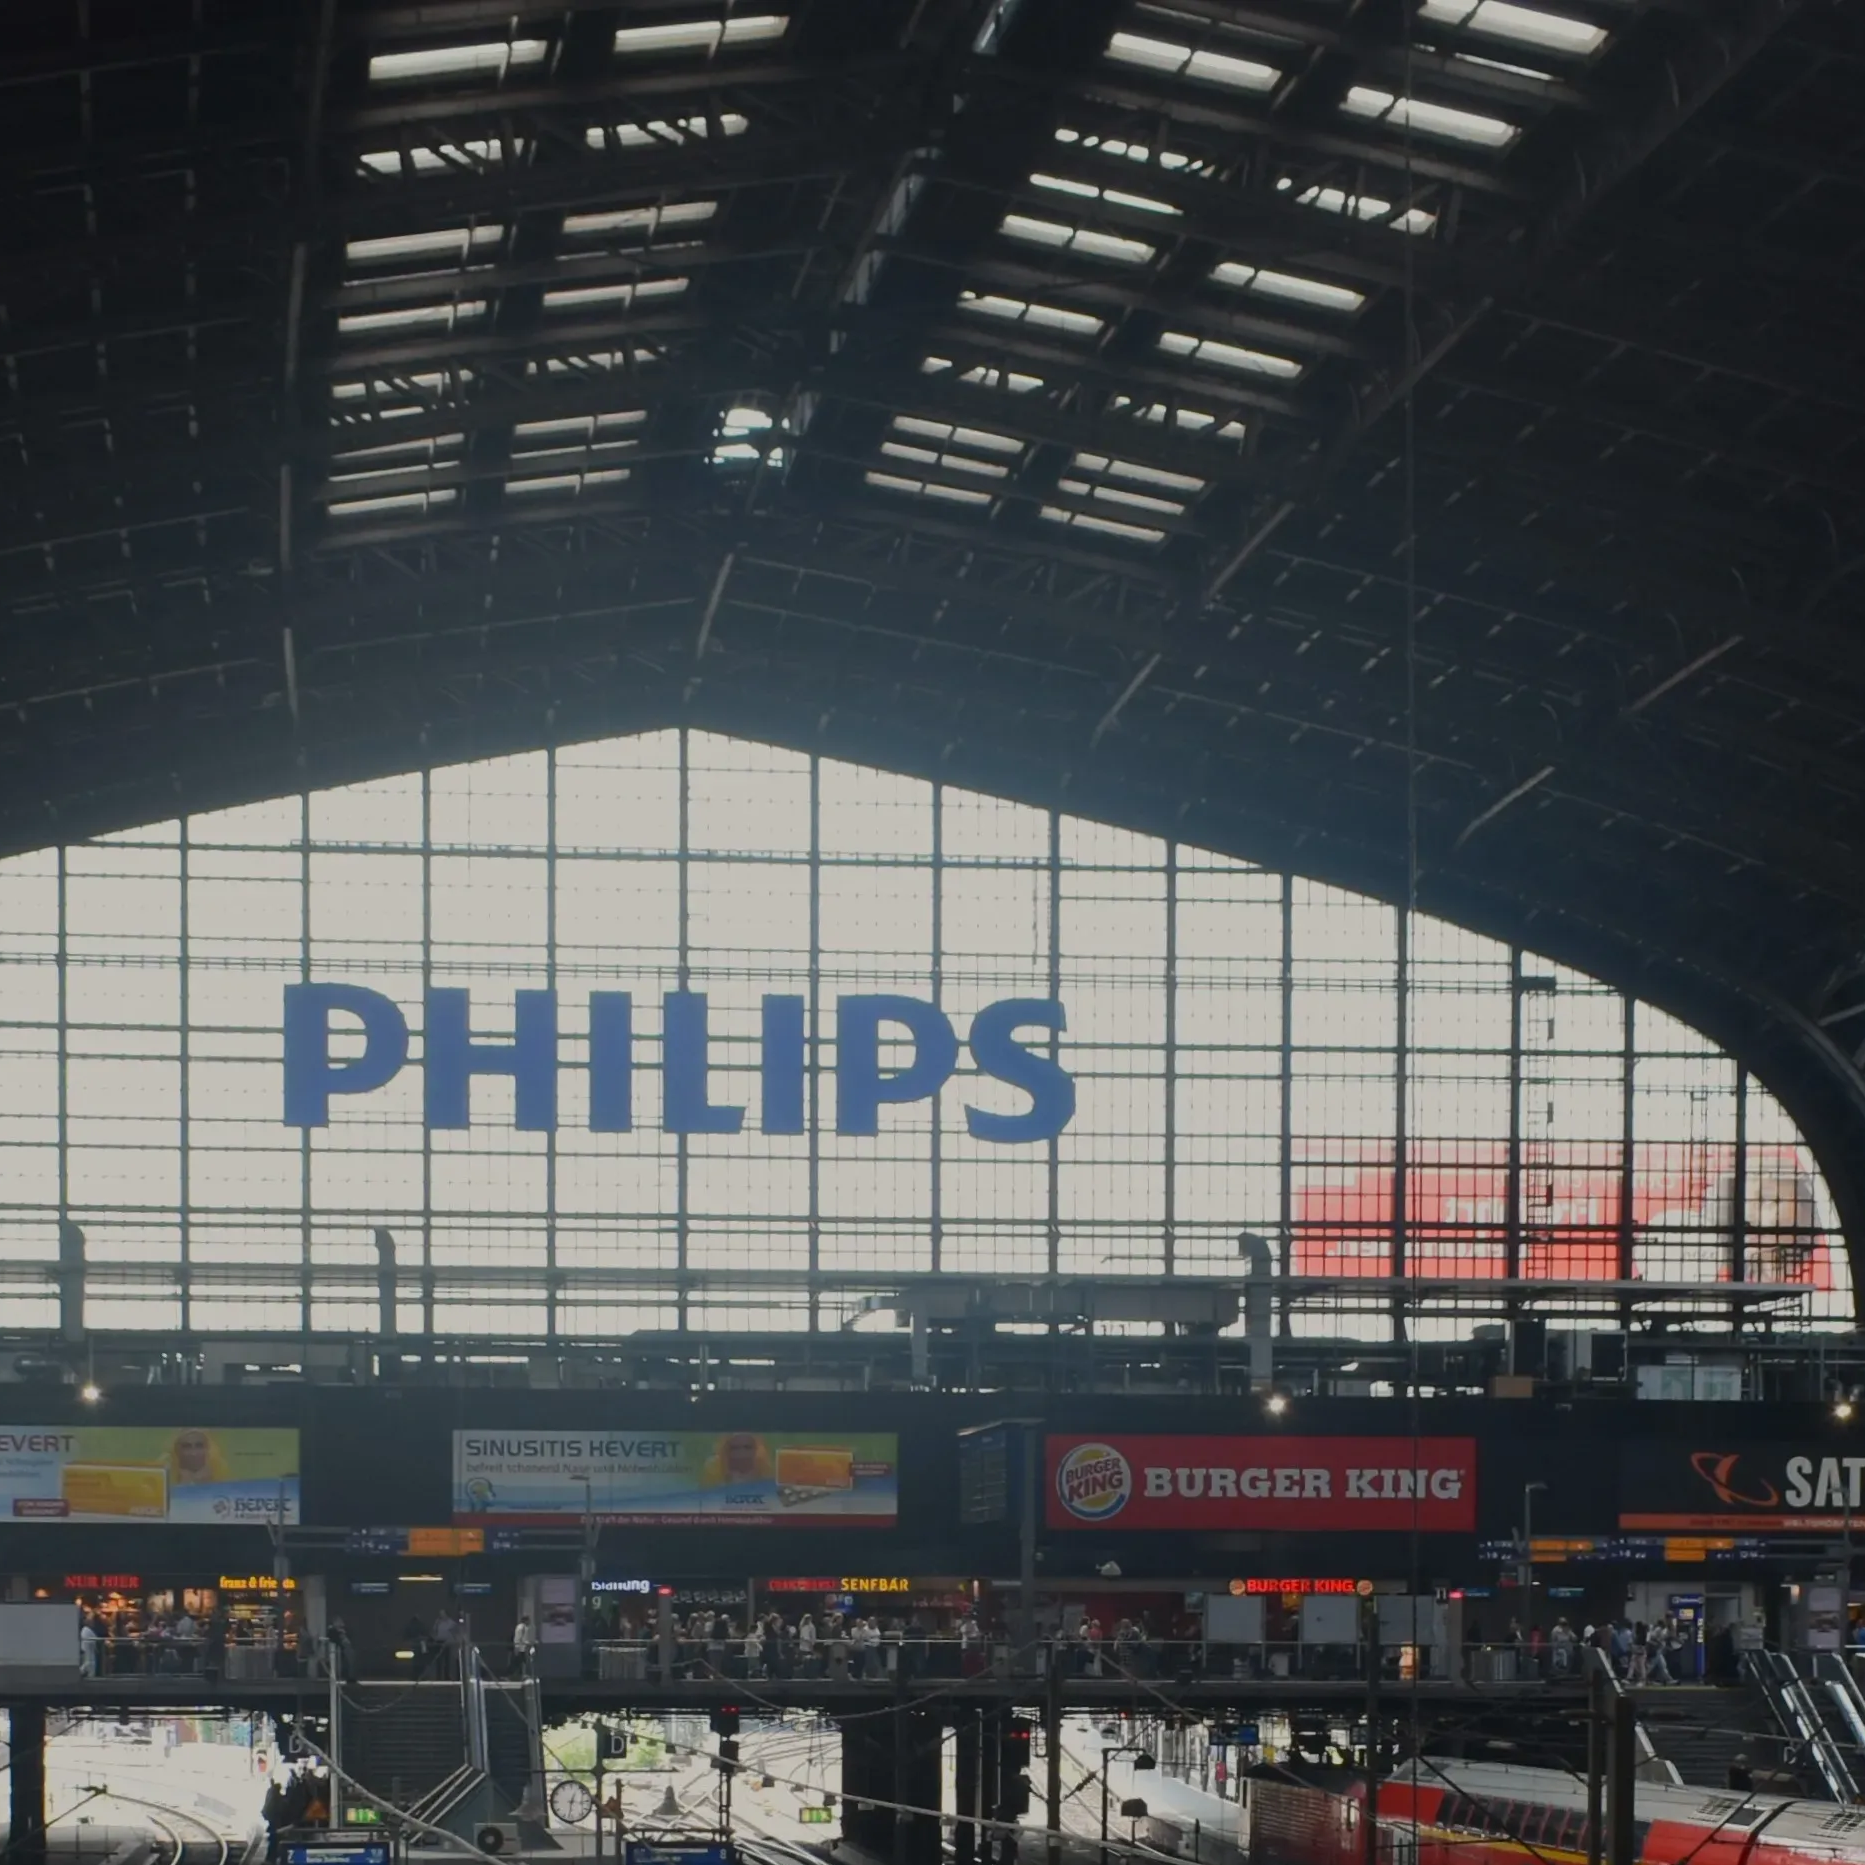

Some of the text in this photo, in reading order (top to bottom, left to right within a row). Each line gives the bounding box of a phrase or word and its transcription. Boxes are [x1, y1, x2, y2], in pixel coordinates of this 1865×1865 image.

[283, 982, 1077, 1144] PHILIPS
[466, 1439, 681, 1459] SINUSITIS HEVERT
[1064, 1456, 1122, 1486] BURGER
[1143, 1467, 1462, 1500] BURGER KING
[1067, 1471, 1124, 1503] KING
[259, 1575, 295, 1590] frieds
[1247, 1578, 1355, 1593] BURGER KING
[610, 1735, 624, 1754] D
